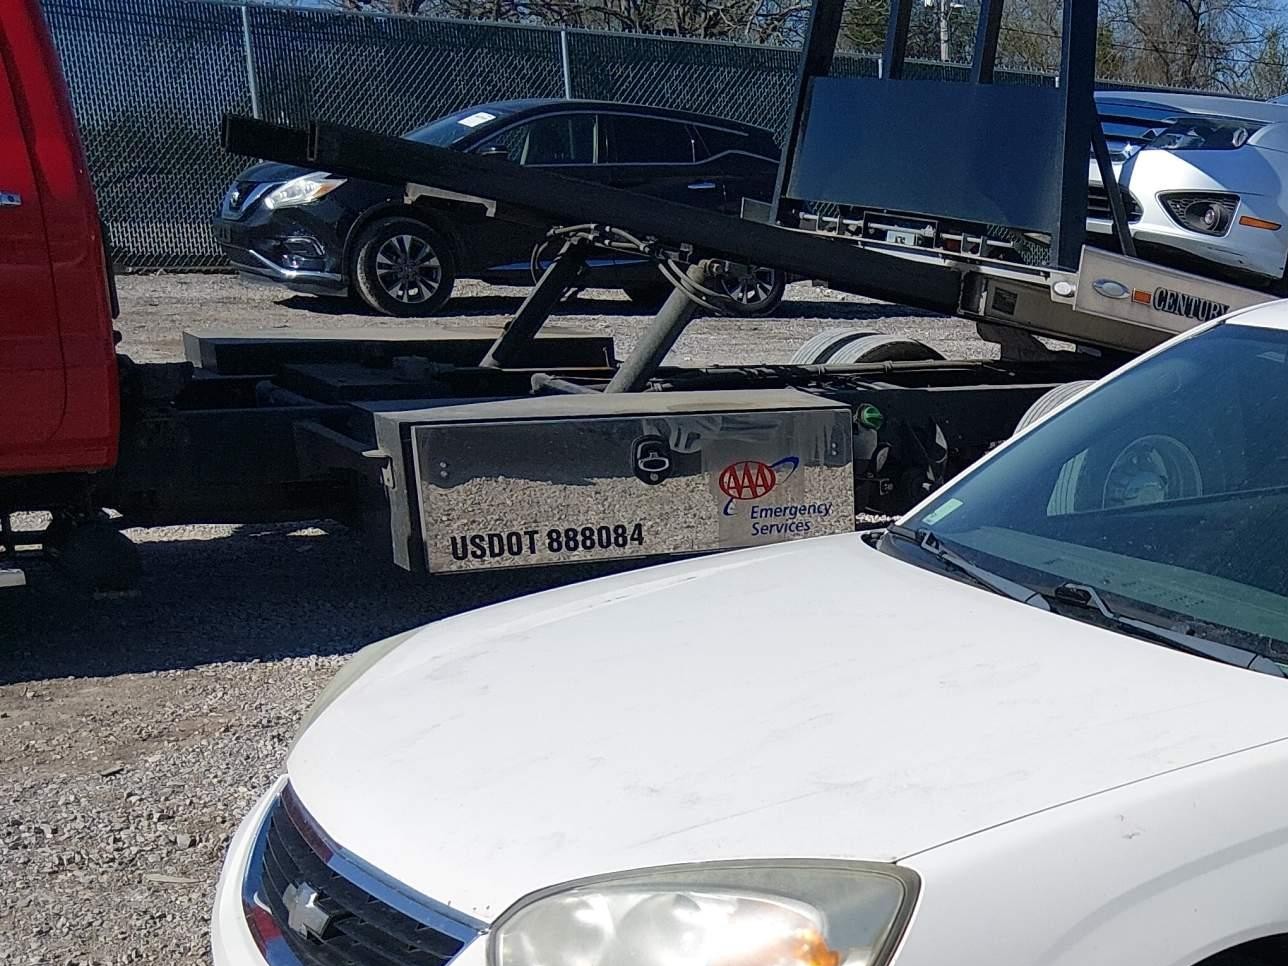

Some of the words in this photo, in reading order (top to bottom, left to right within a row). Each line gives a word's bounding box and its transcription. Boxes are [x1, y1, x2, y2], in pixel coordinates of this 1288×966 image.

[726, 462, 771, 499] AAA
[751, 502, 832, 521] Emergency
[450, 530, 539, 560] USDOT
[547, 523, 645, 552] 888084
[751, 520, 811, 536] Services
